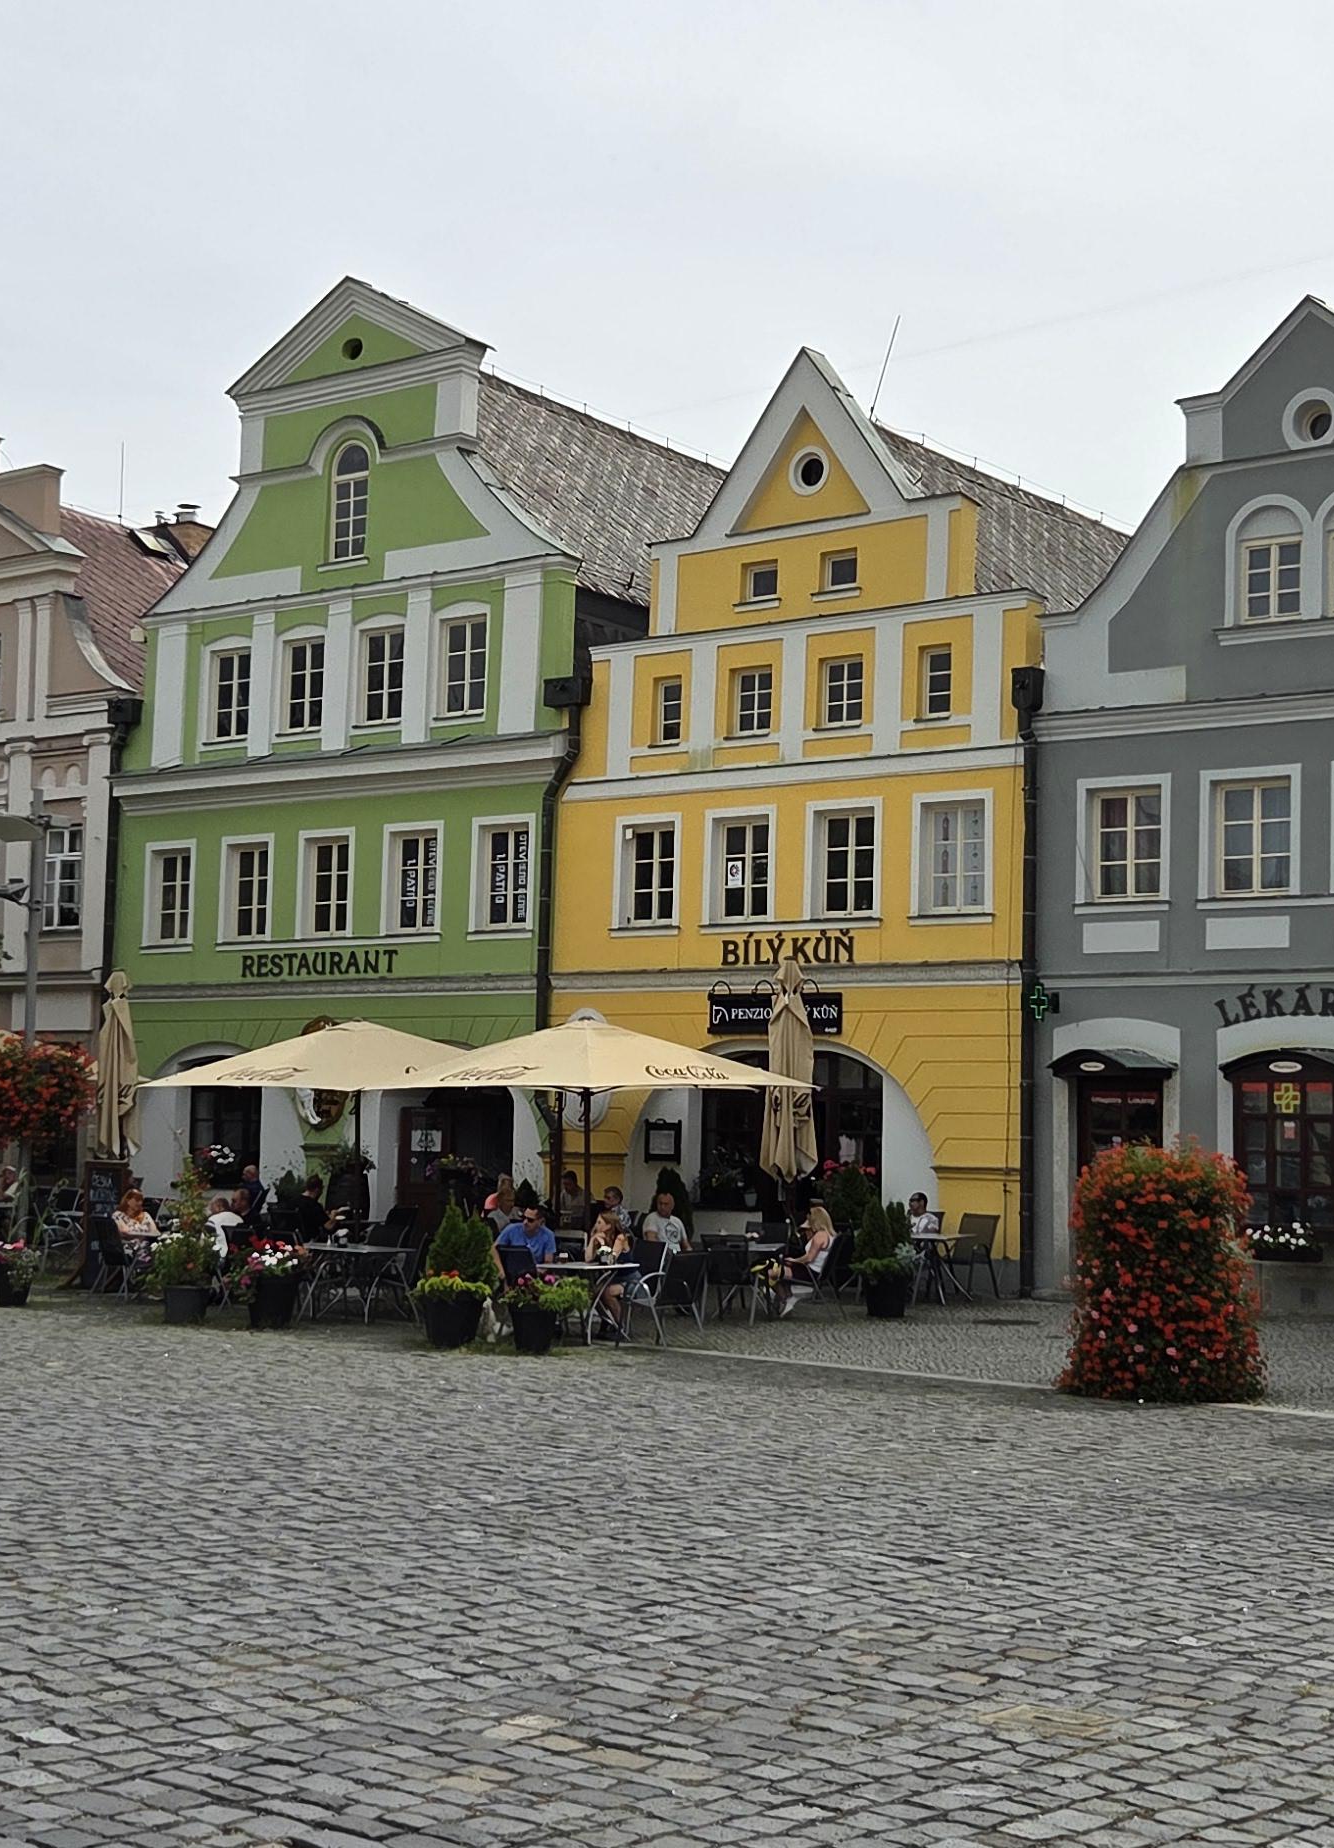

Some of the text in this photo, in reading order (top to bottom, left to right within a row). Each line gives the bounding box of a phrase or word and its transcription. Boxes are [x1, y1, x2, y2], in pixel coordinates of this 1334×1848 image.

[721, 929, 854, 966] BÍLÝ KŮŇ
[241, 950, 398, 978] RESTAURANT
[731, 1008, 773, 1020] PENZIO
[812, 1004, 838, 1019] KŮŇ
